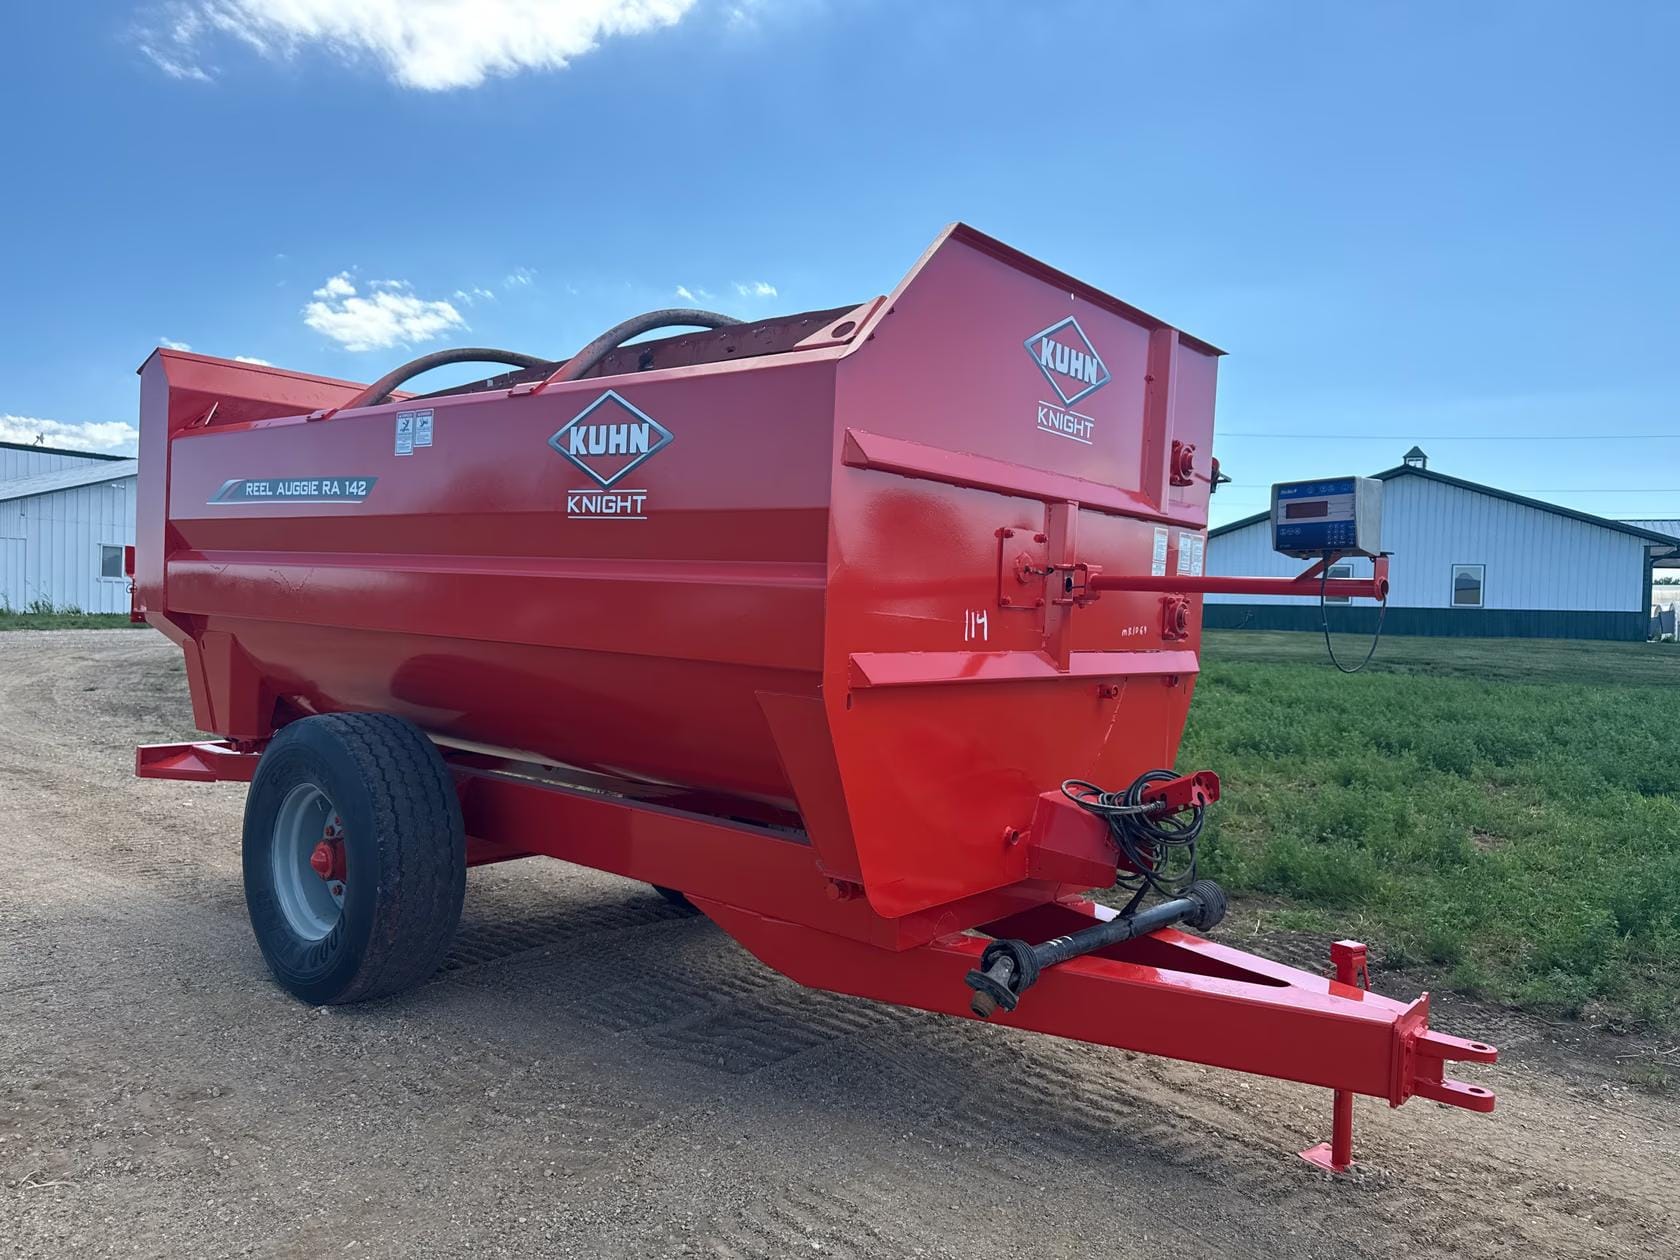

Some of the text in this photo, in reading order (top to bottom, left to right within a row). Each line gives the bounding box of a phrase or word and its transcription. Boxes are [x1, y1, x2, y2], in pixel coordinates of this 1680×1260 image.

[1041, 336, 1098, 385] KUHN
[1037, 406, 1094, 438] KNIGHT
[569, 423, 650, 455] KUHN
[245, 481, 367, 496] REEL AUGGIE RA 142
[567, 495, 647, 514] KNIGHT
[964, 608, 988, 642] 114
